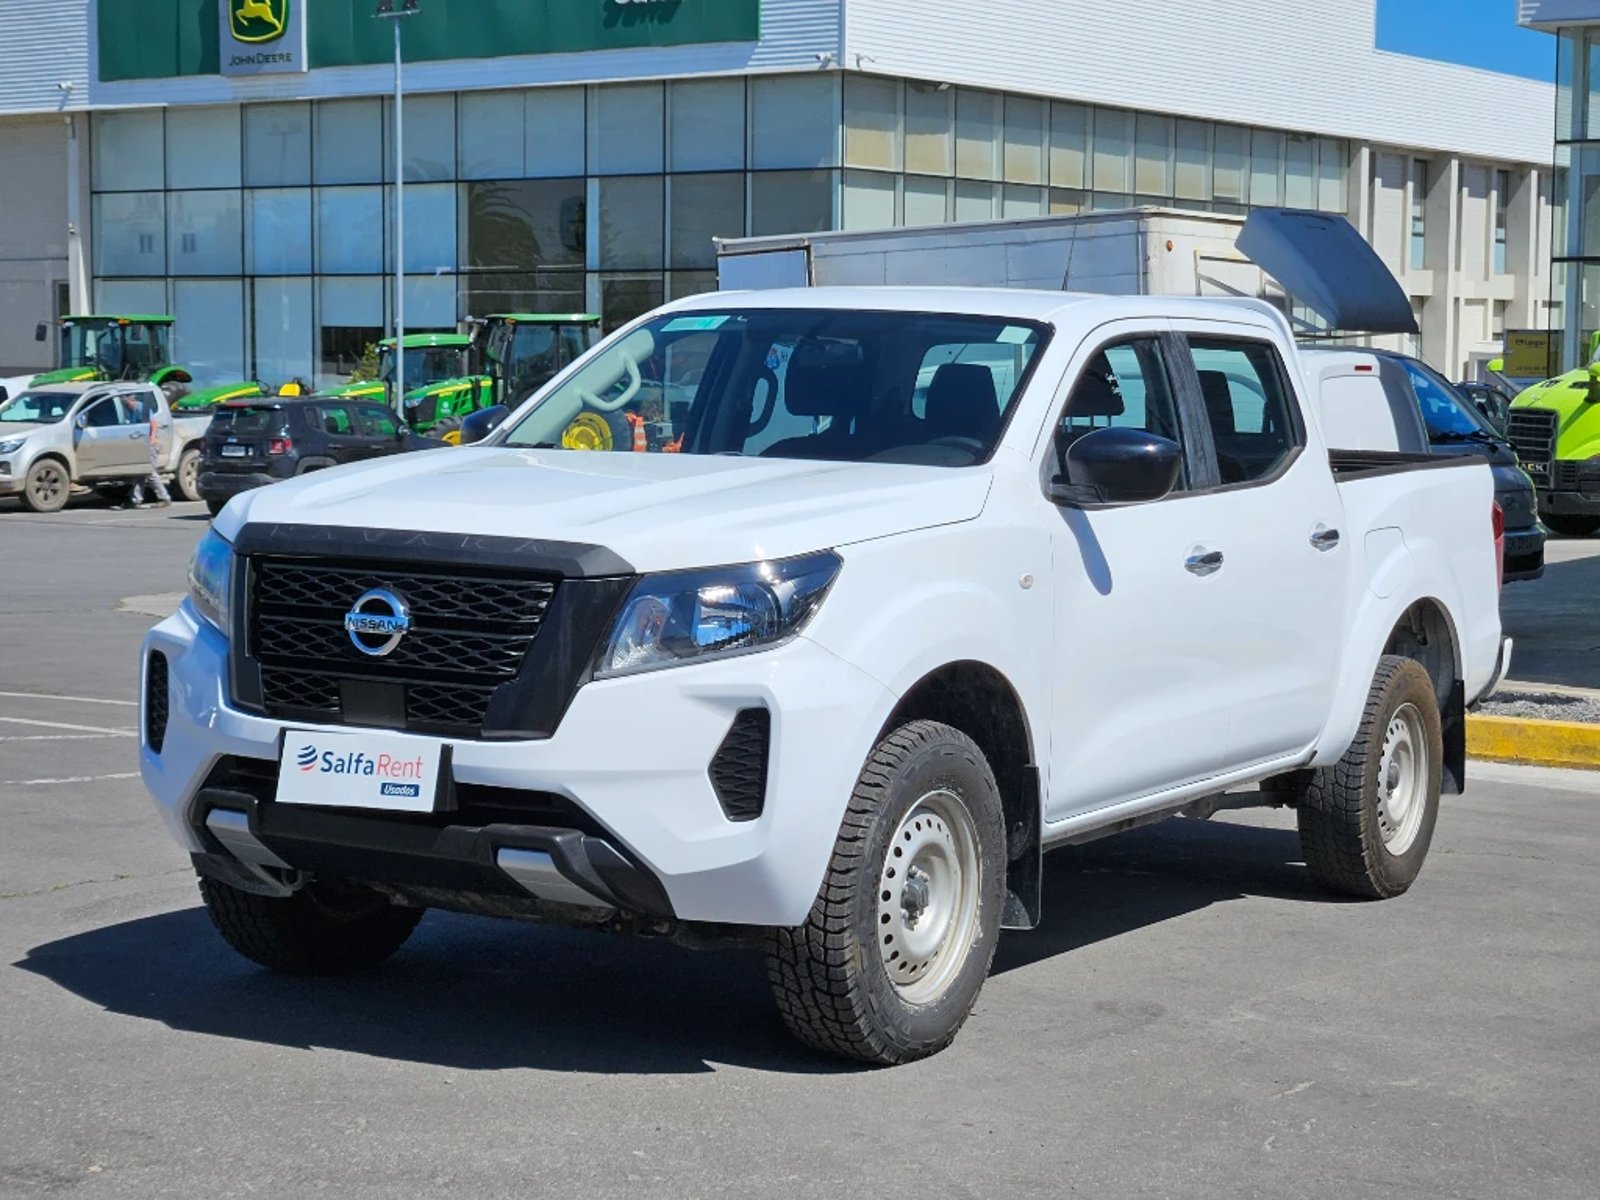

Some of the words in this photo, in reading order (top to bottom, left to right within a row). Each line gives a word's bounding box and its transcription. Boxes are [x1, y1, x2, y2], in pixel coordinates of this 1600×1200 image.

[228, 54, 256, 67] JOHN
[256, 52, 292, 64] DEERE
[1519, 463, 1544, 472] ACK
[348, 616, 398, 632] NISSAN
[320, 750, 423, 779] SalfaRent
[383, 784, 415, 797] Usados
